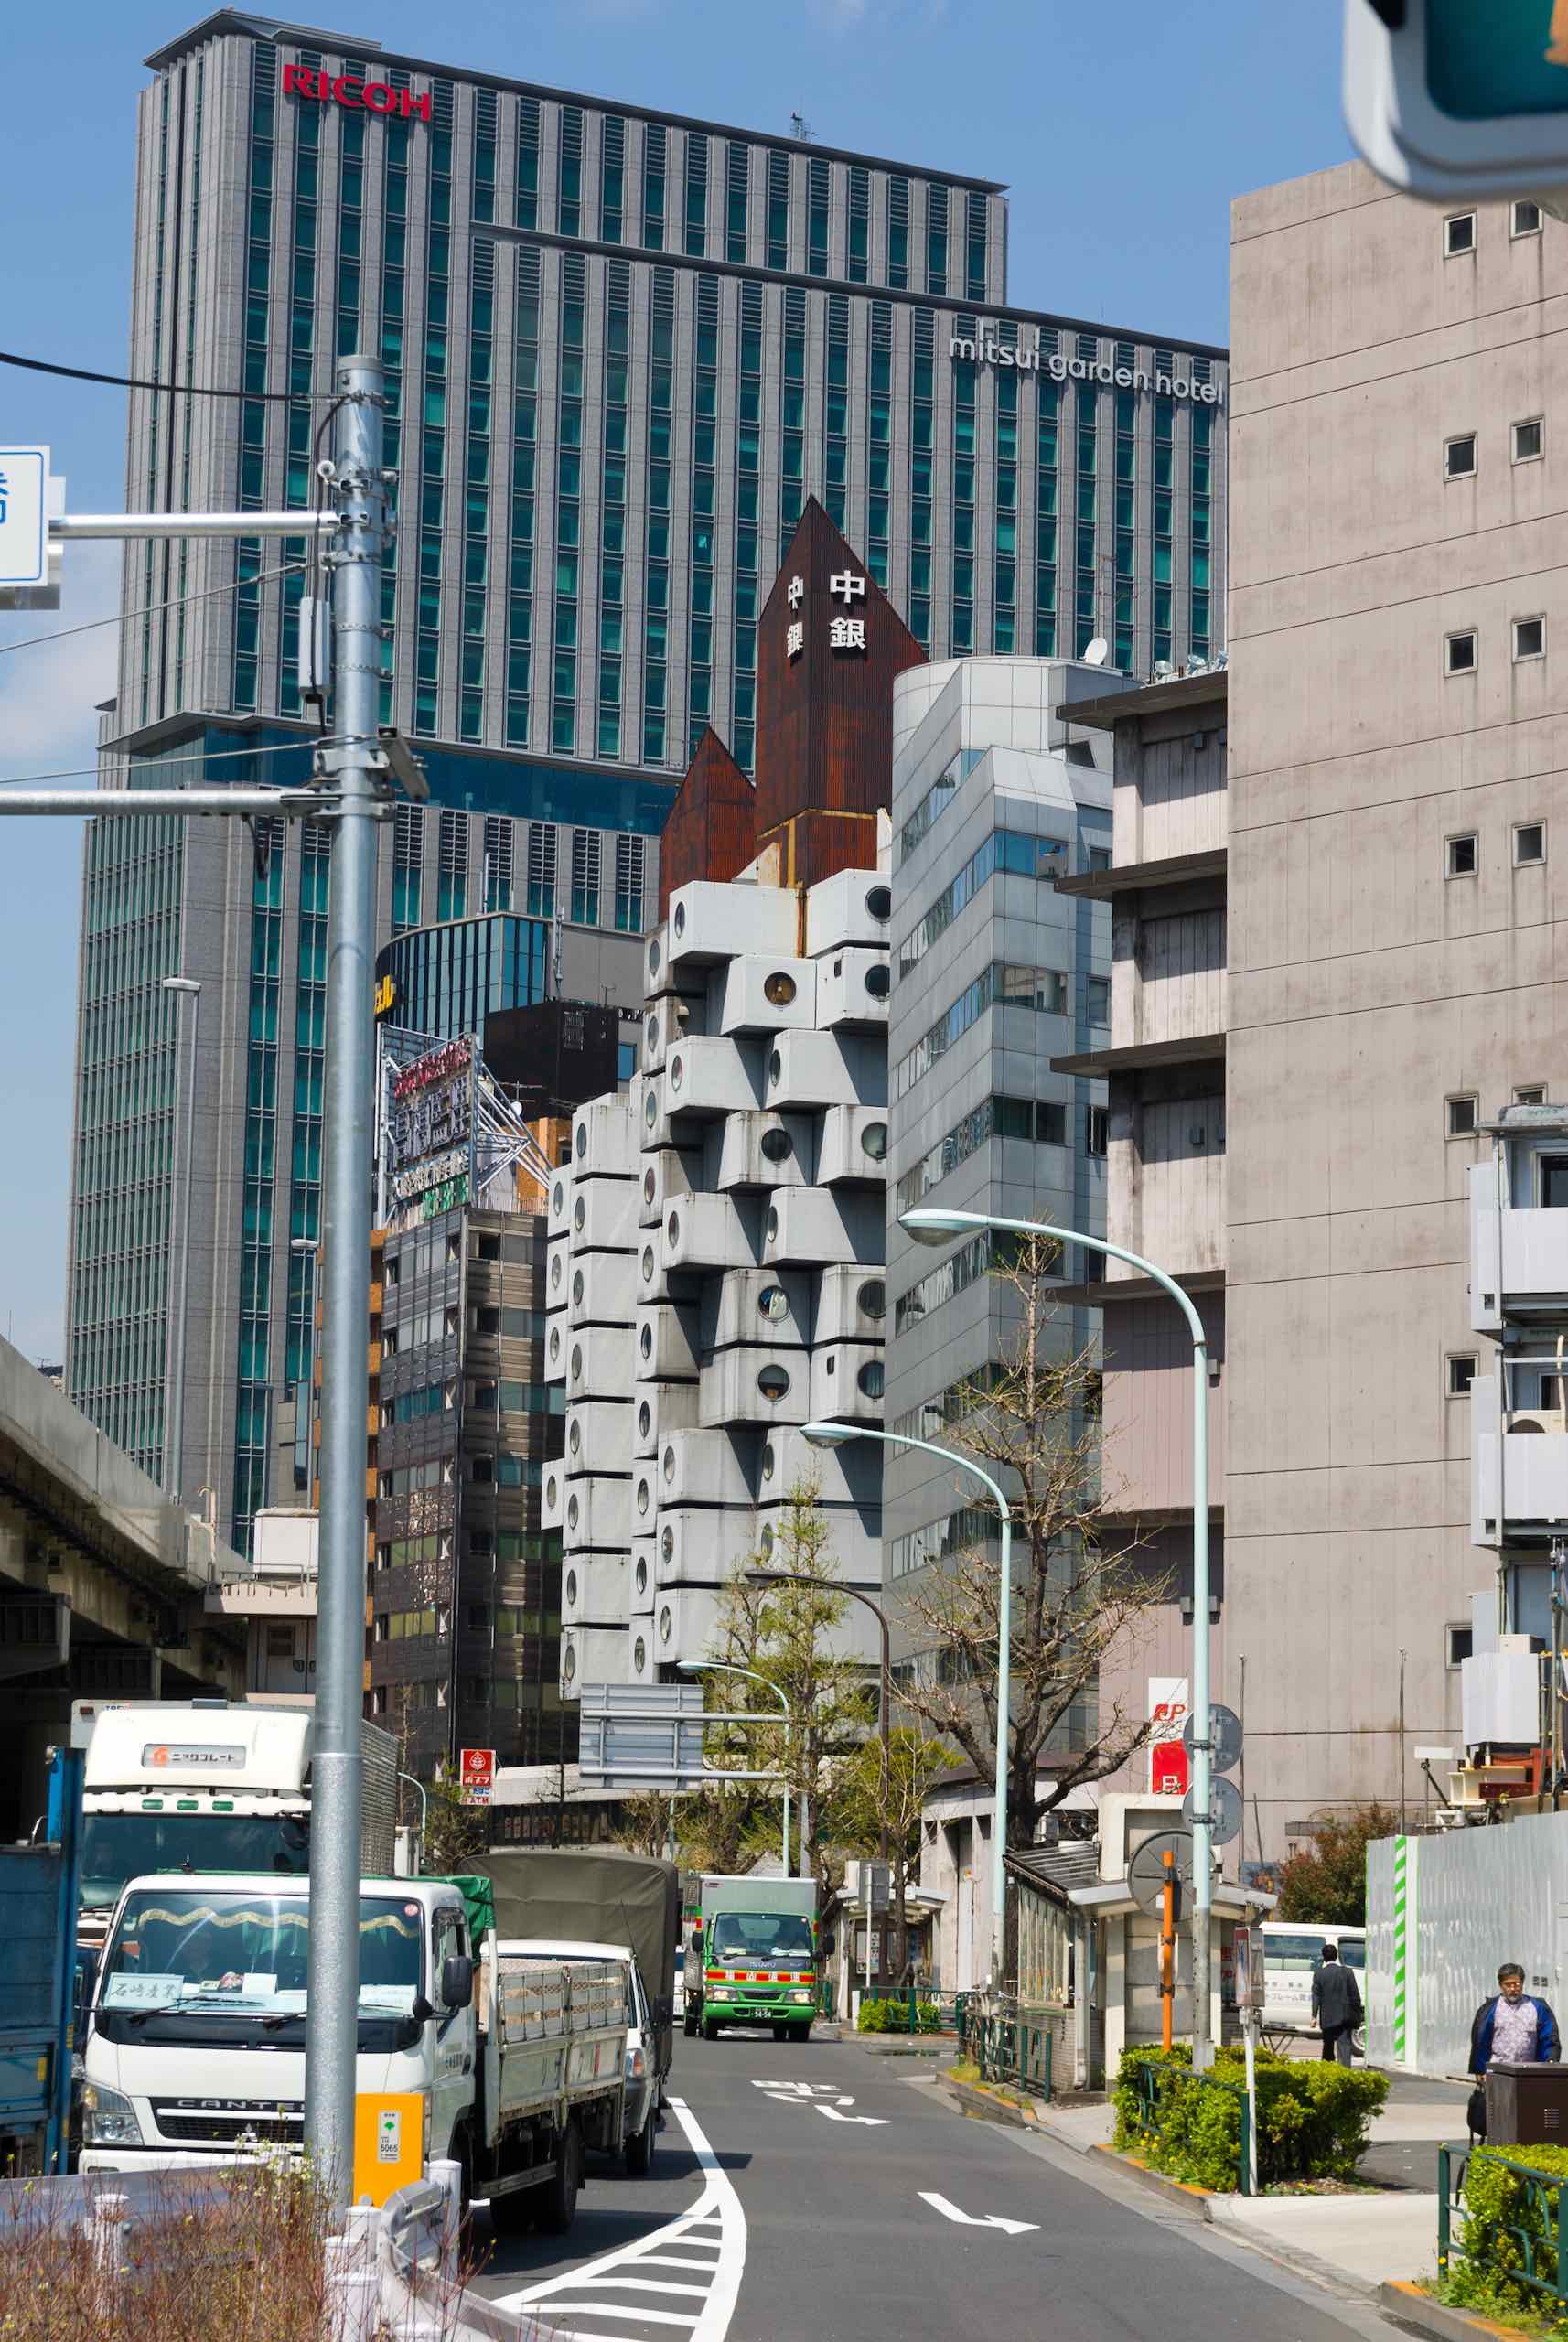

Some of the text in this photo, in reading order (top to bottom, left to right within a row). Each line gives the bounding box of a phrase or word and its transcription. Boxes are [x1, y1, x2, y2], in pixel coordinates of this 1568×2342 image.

[283, 64, 431, 123] RICOH
[950, 320, 1224, 405] mitsui garden hotel
[829, 569, 866, 650] 中銀
[177, 2100, 305, 2111] CANTE
